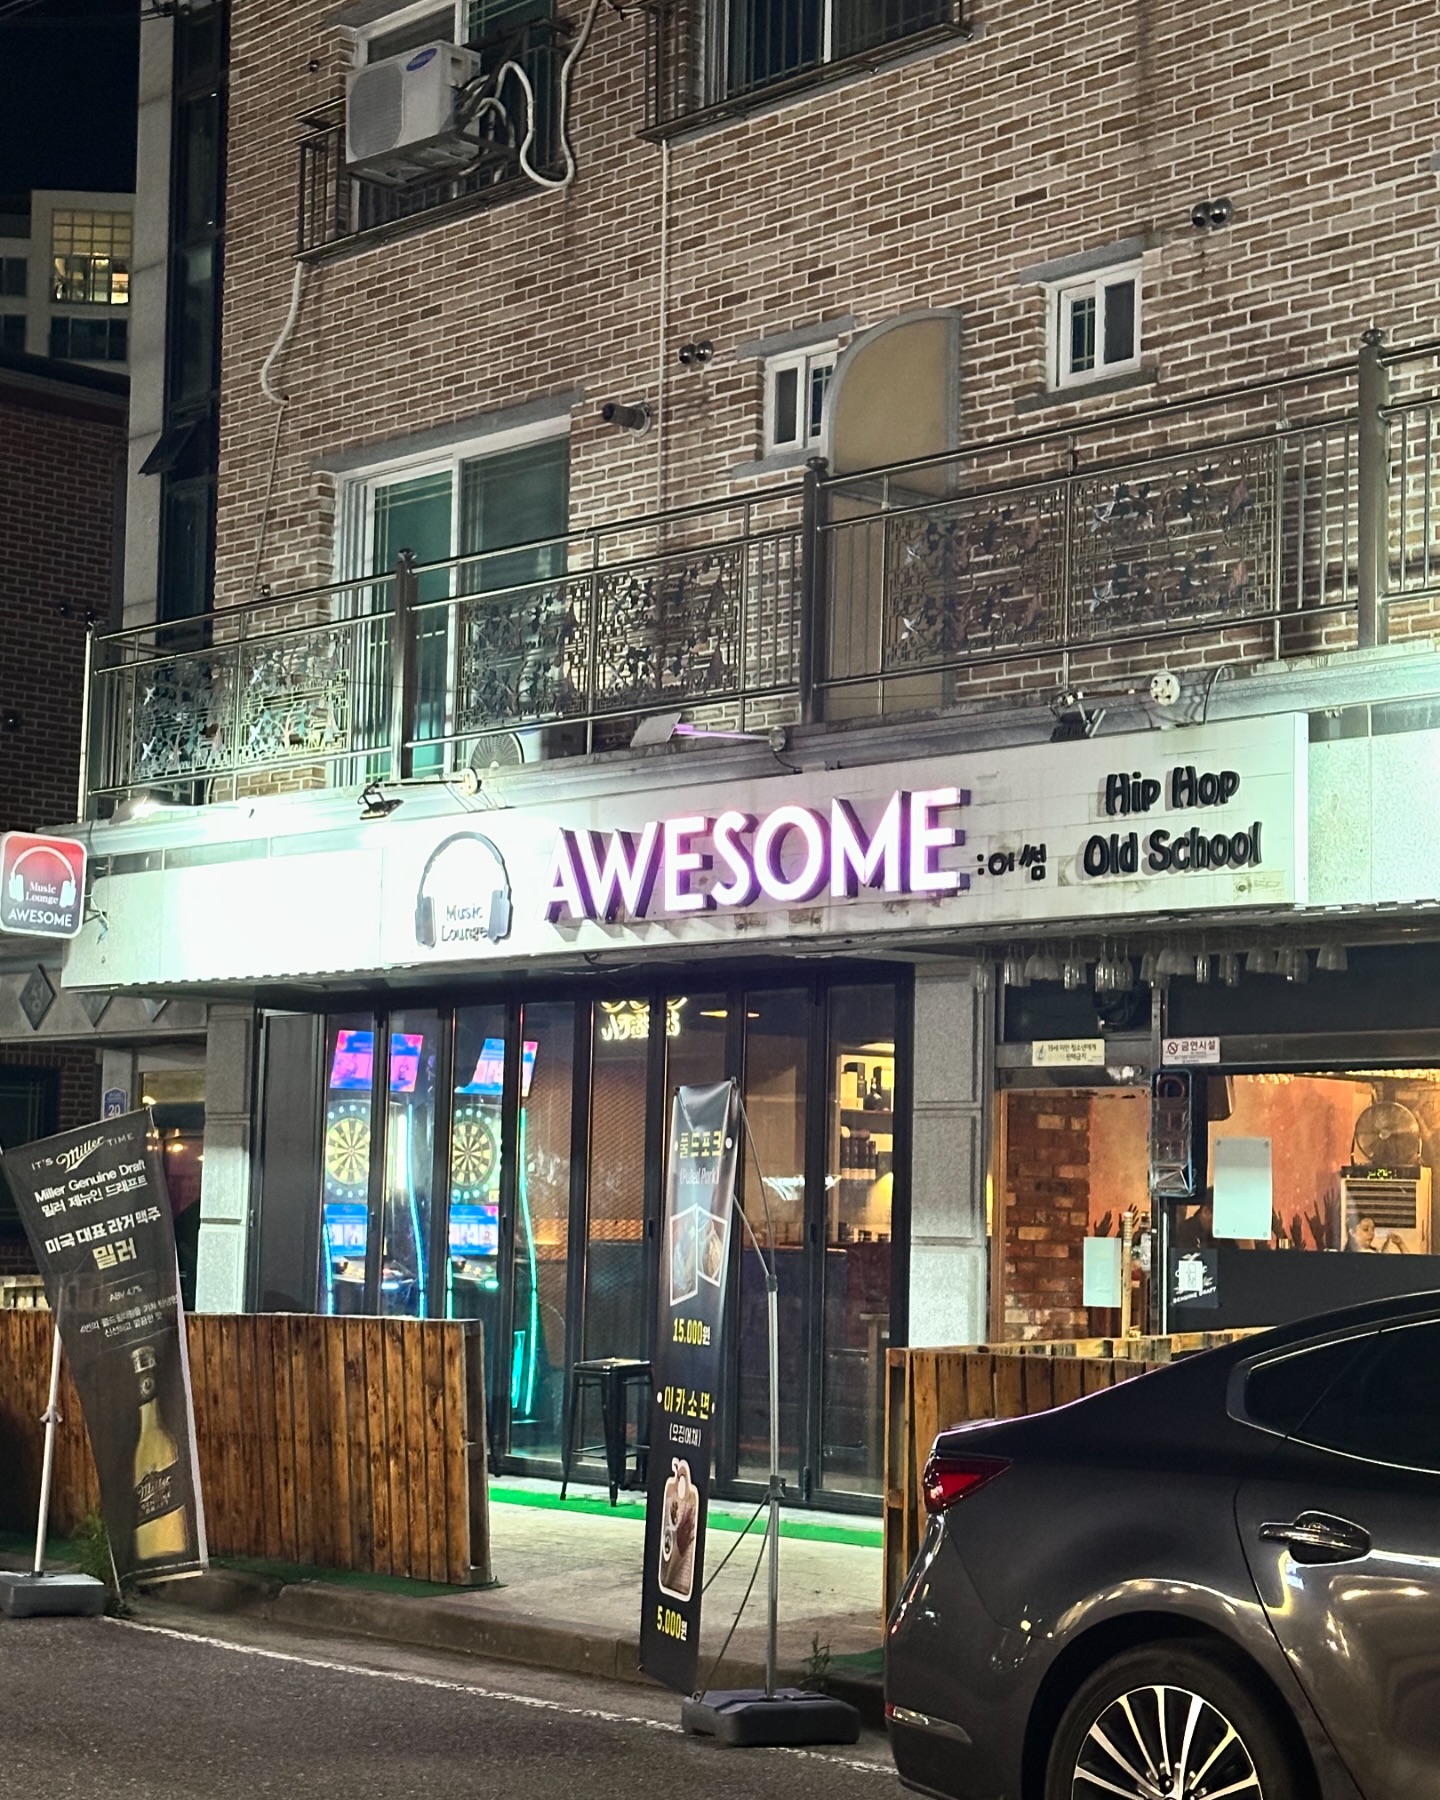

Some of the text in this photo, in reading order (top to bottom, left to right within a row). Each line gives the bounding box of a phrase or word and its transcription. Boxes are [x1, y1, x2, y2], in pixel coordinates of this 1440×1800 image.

[544, 787, 971, 923] AWESOME
[1084, 821, 1263, 876] Old School
[25, 891, 59, 905] Lounge
[29, 881, 57, 894] Music
[8, 908, 73, 928] AWESOME
[446, 903, 483, 921] Music
[441, 925, 489, 942] Lounge
[1181, 1039, 1216, 1051] 금연시설
[108, 1104, 121, 1117] 20
[31, 1132, 135, 1173] IT'S Miller TIME
[34, 1159, 146, 1203] Miller Genuine Draft
[41, 1199, 67, 1218] 밀러
[67, 1187, 104, 1208] 제뉴인
[44, 1206, 161, 1254] 미국 대표 라거 맥주
[92, 1237, 137, 1270] 밀러
[664, 1385, 711, 1420] 이카소면
